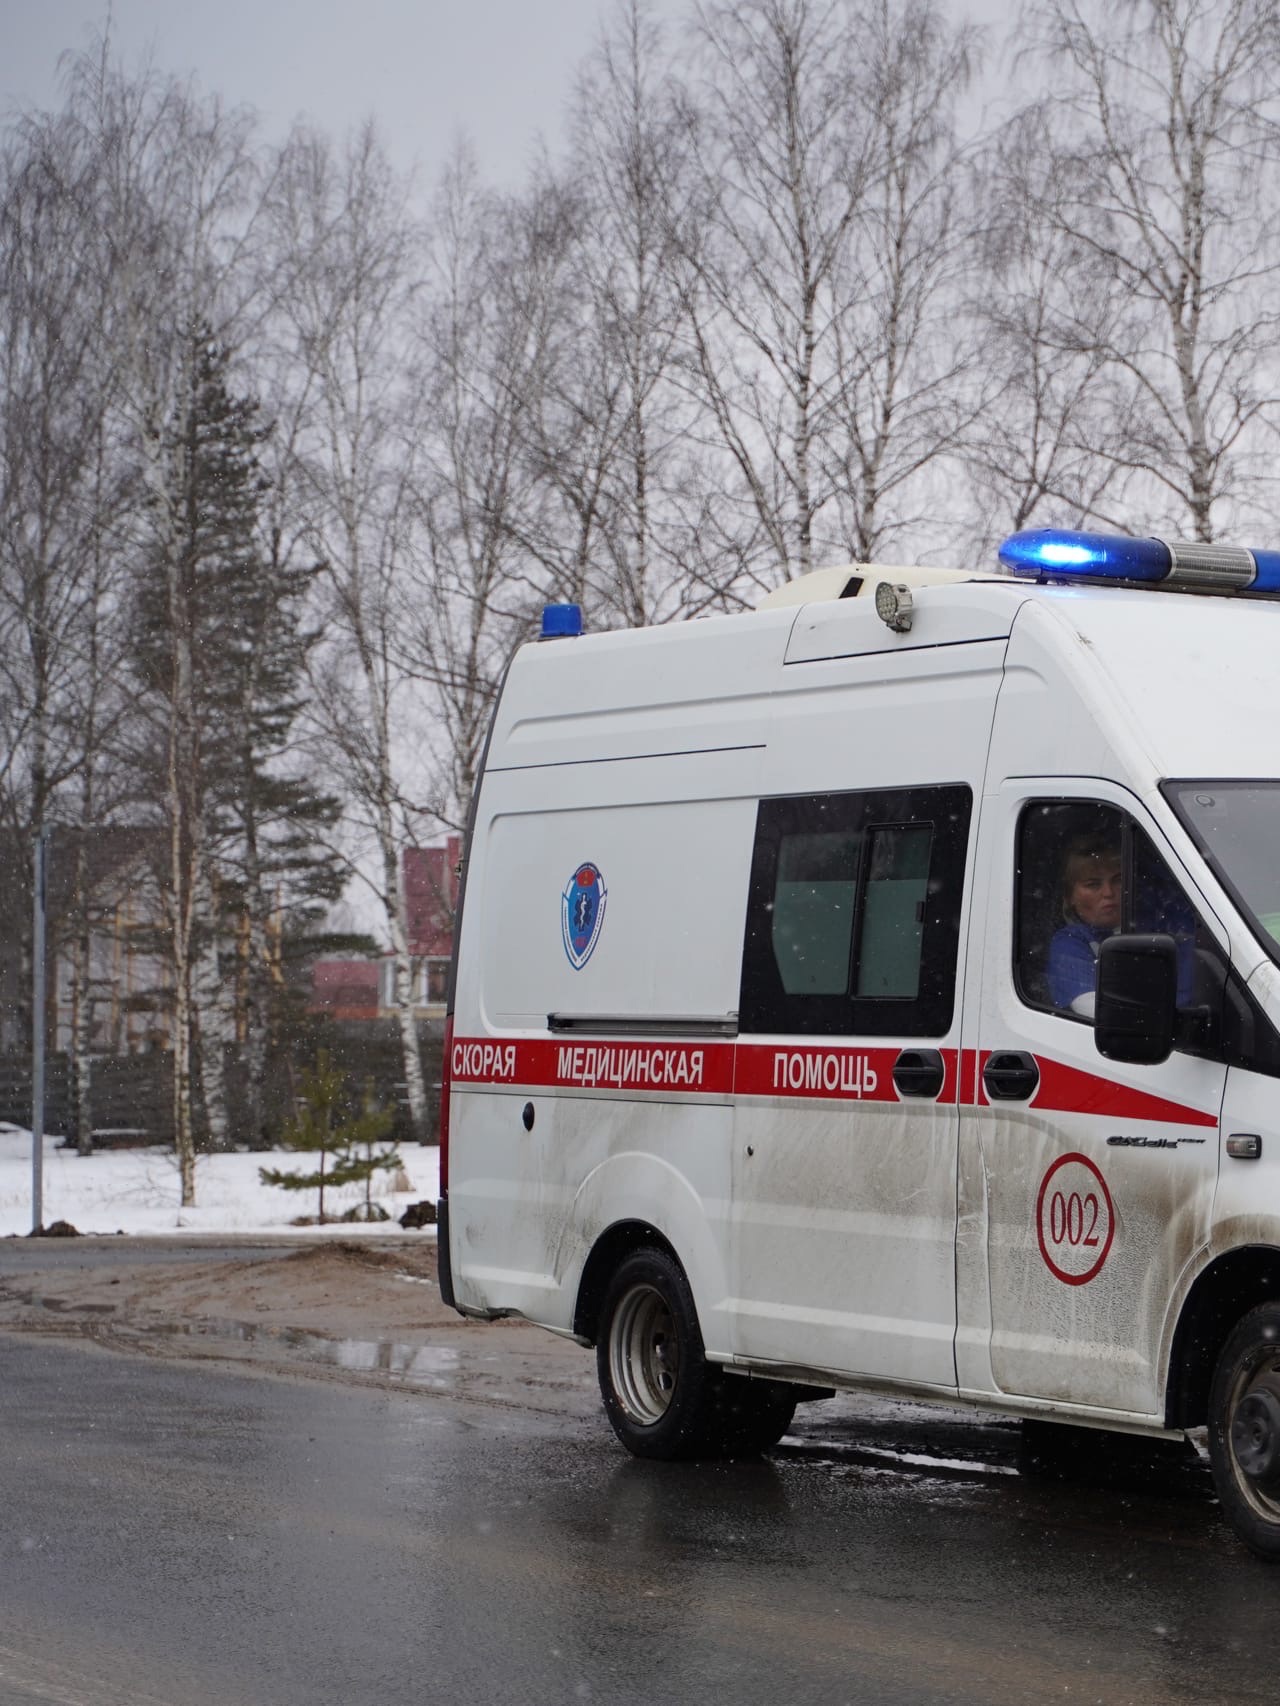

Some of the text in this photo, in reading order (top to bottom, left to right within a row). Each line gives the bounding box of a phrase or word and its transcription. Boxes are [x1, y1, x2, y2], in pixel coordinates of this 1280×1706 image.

[452, 1044, 877, 1098] СКОРАЯ МЕДИЦИНСКАЯ ПОМОЩЬ
[1050, 1191, 1100, 1247] 002
